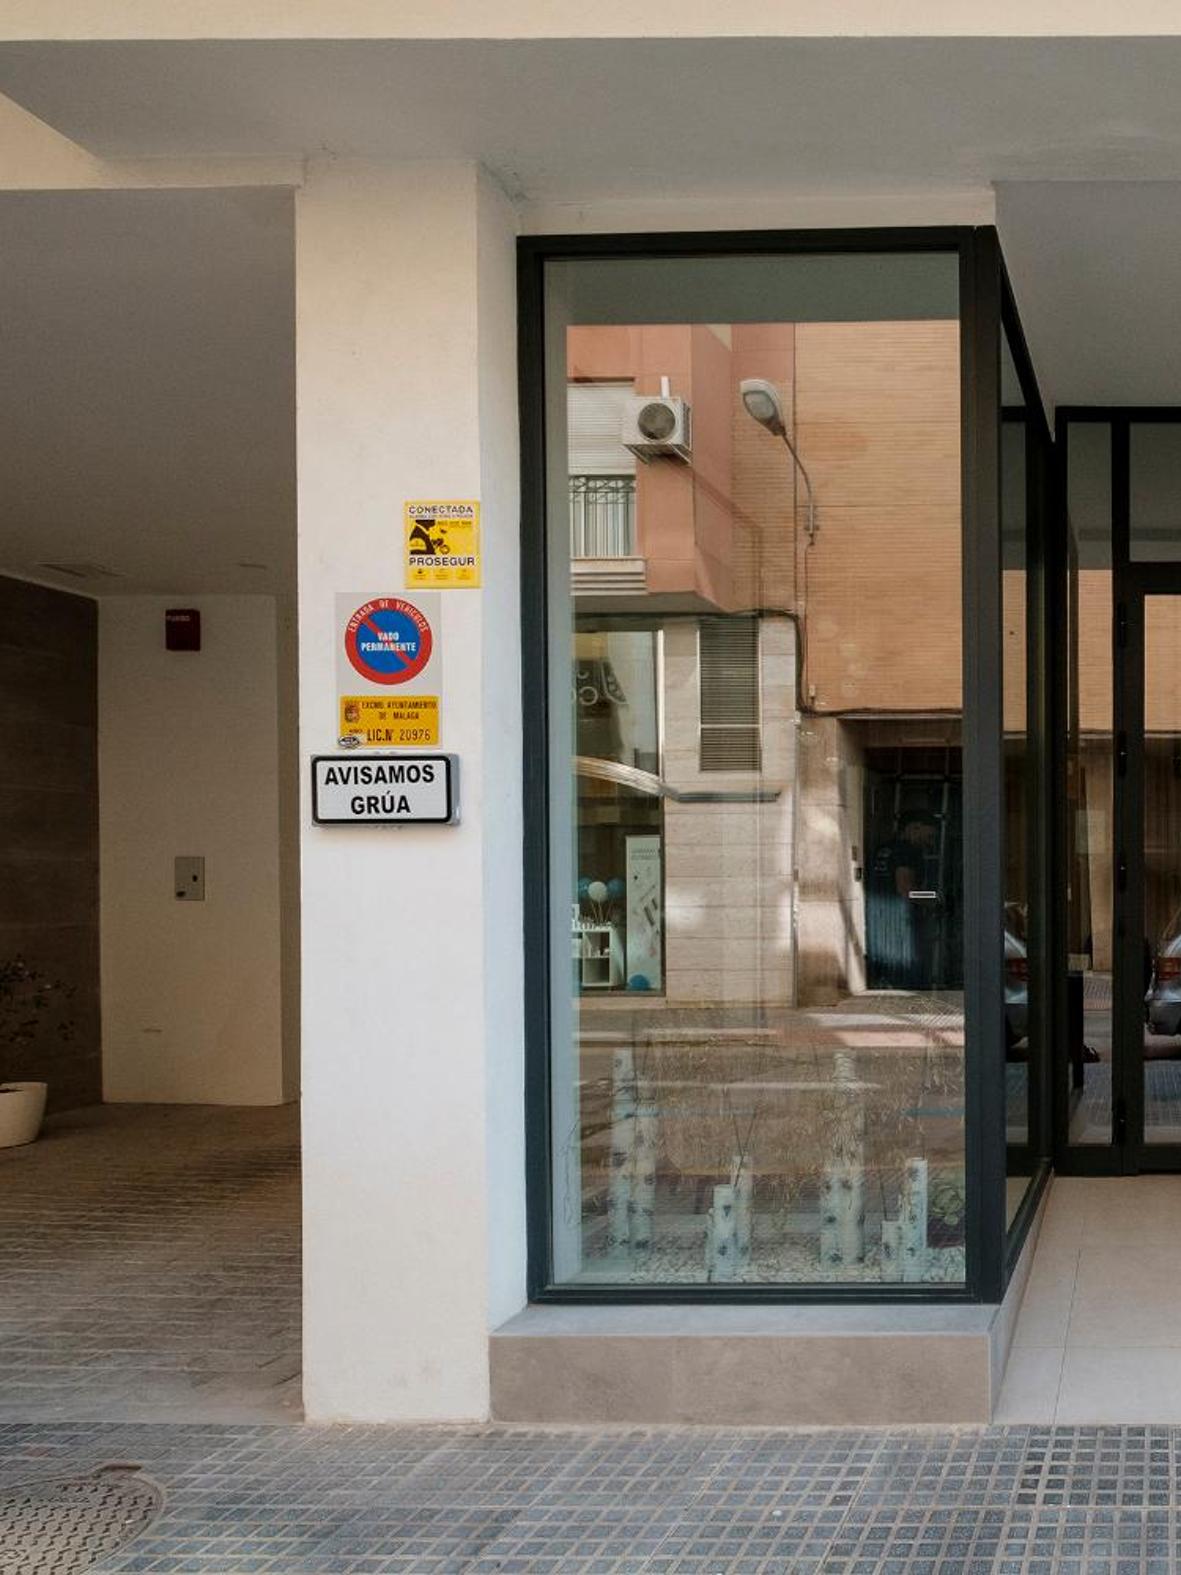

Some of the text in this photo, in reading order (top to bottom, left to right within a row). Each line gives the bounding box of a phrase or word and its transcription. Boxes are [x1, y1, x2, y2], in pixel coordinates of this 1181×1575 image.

[408, 505, 473, 514] CONECTADA
[409, 557, 475, 566] PROSEGUR
[377, 632, 400, 641] VADO
[360, 642, 417, 651] PERMANENTE
[386, 701, 438, 709] AYUNTAMIENTO
[399, 728, 431, 741] 20976
[325, 765, 435, 785] AVISAMOS
[351, 790, 411, 814] GRÚA
